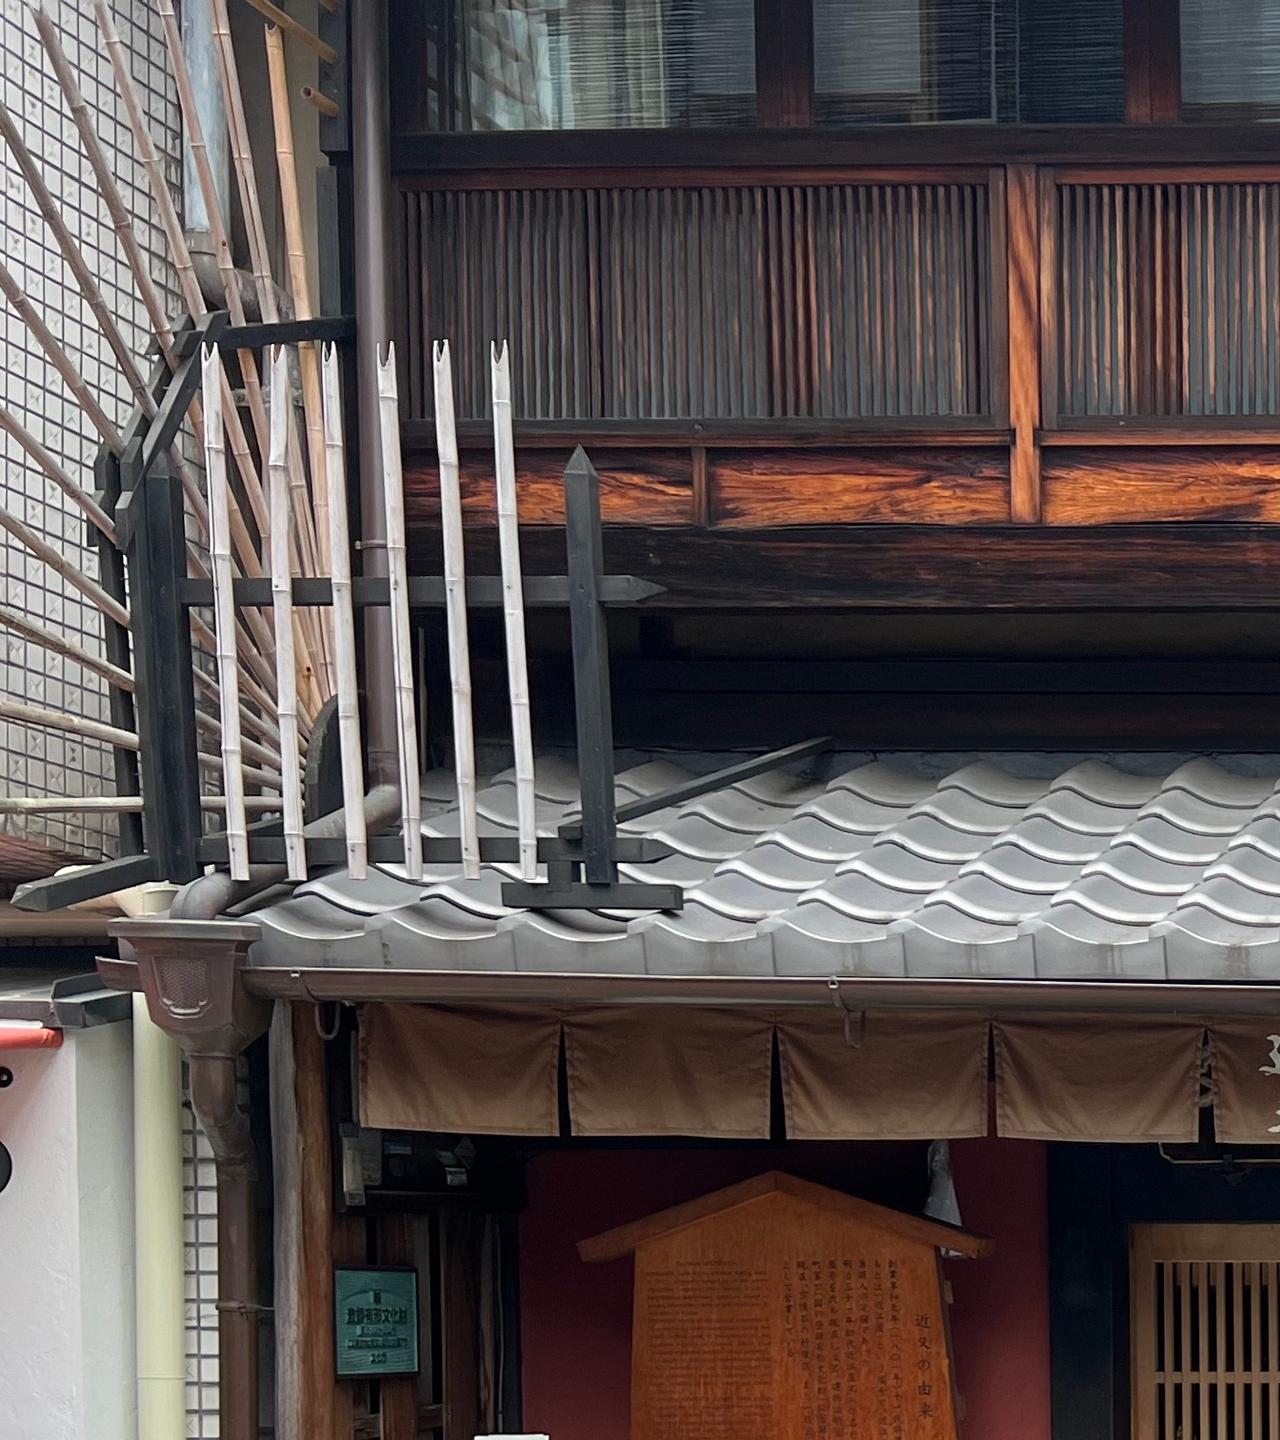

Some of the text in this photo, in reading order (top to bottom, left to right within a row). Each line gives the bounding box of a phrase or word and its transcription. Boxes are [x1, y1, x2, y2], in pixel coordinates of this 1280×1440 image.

[914, 1312, 936, 1421] 近又の由来
